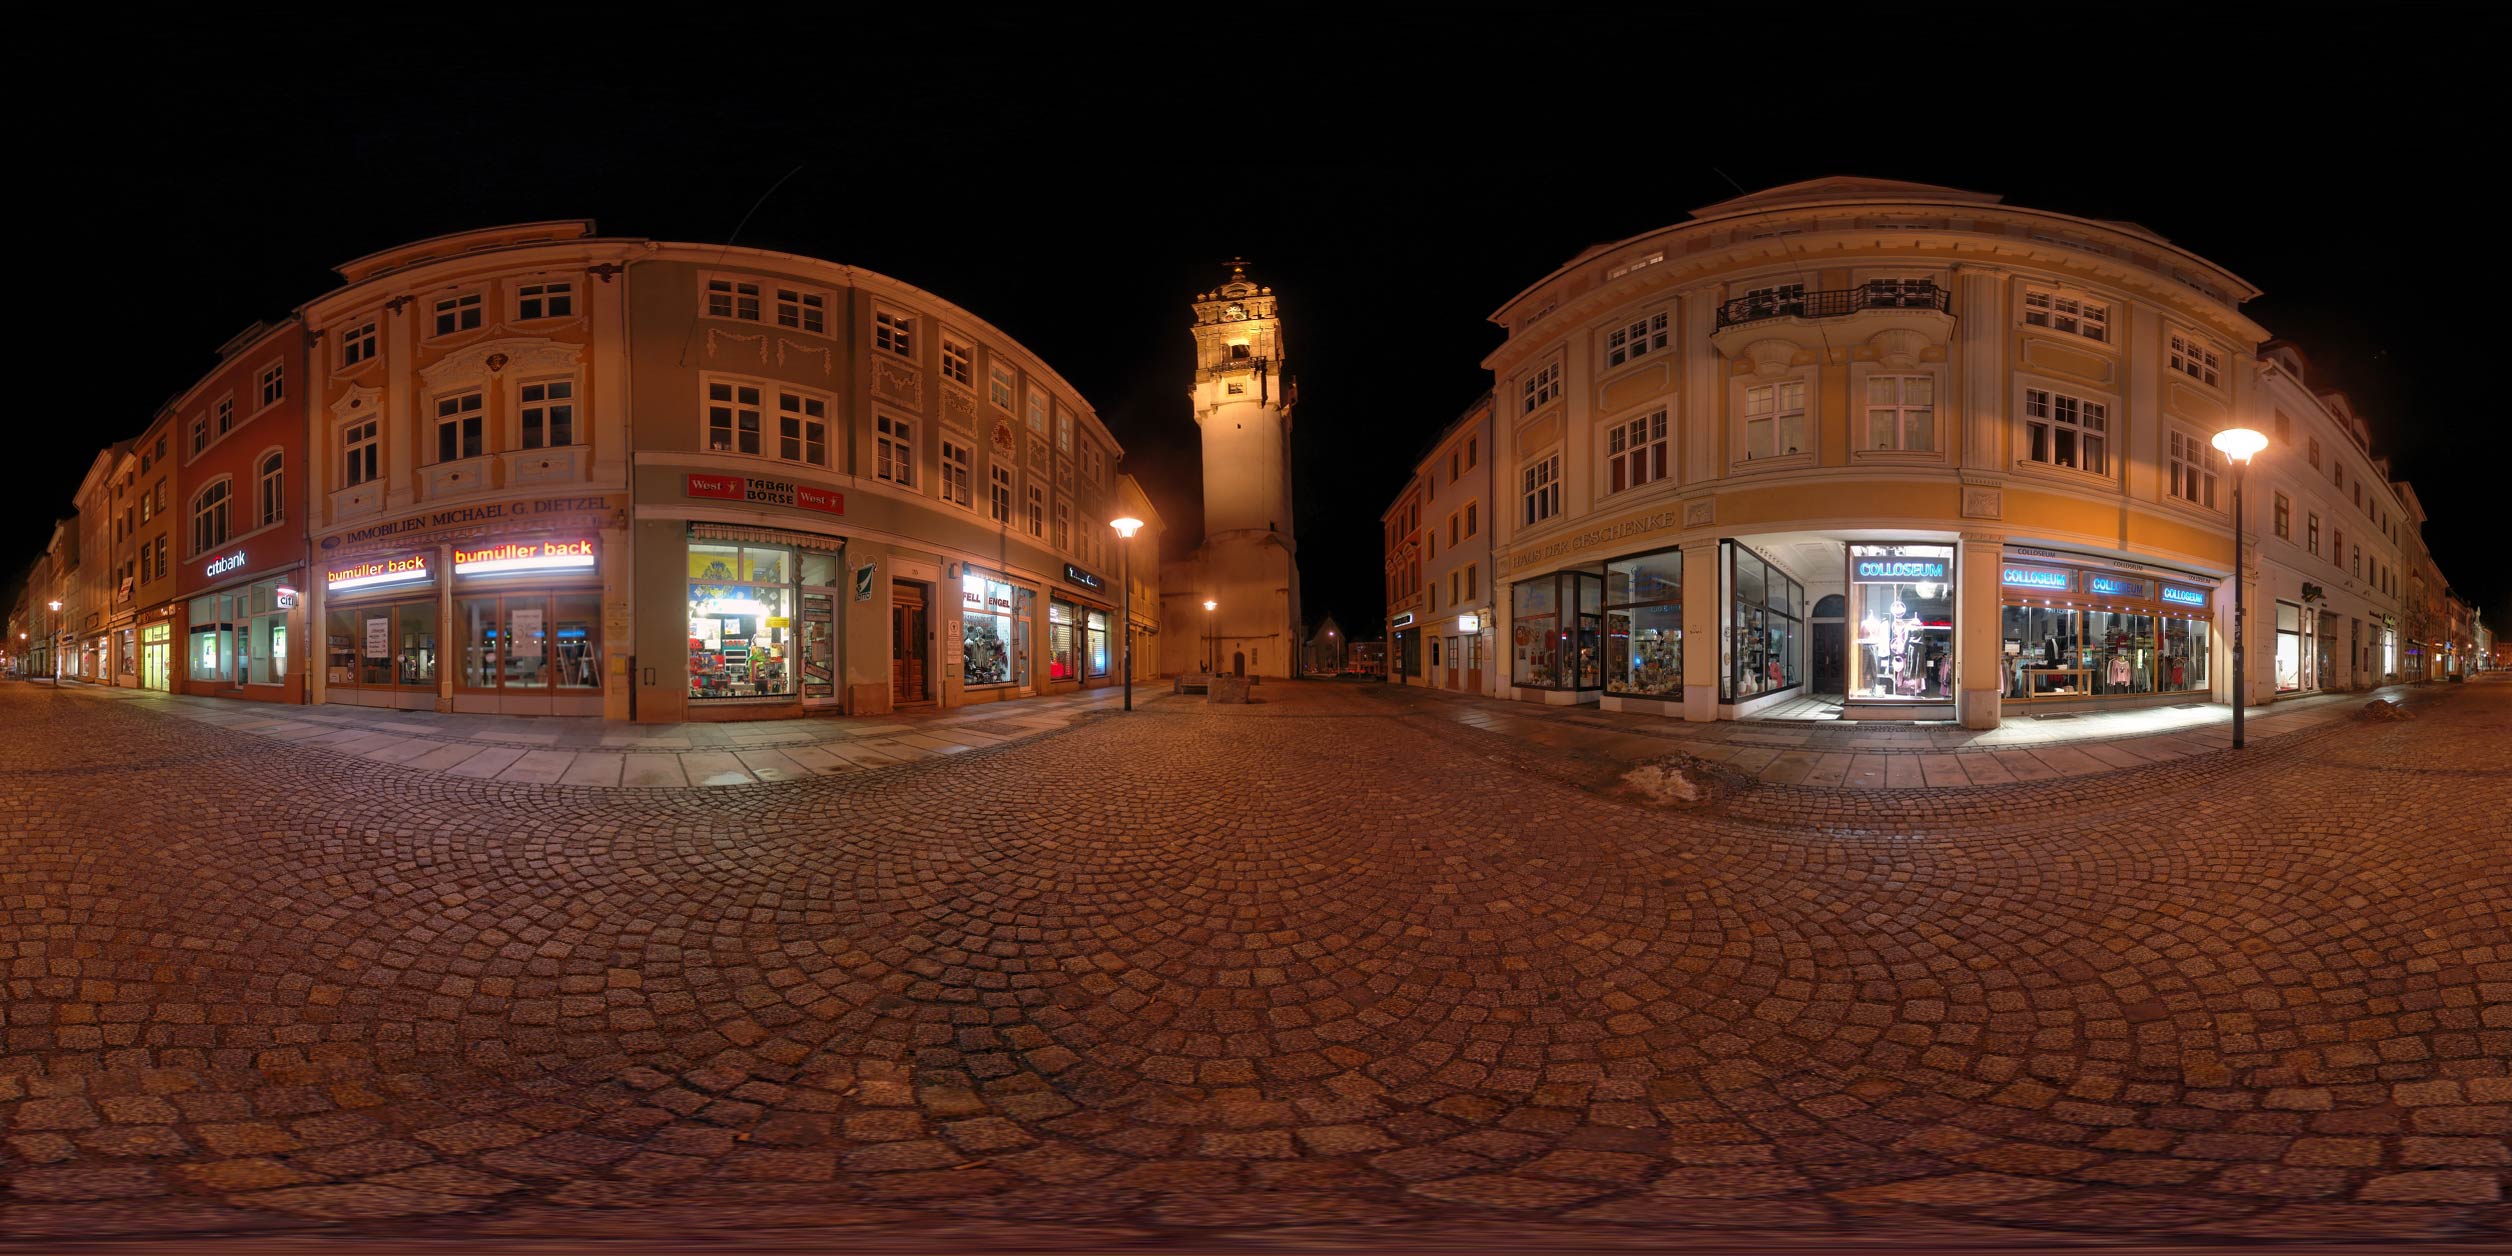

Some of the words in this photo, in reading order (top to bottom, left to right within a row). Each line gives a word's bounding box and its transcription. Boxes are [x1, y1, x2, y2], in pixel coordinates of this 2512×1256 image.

[692, 479, 723, 491] West
[746, 478, 794, 493] TABAK
[746, 489, 794, 505] BÖRSE
[800, 492, 826, 504] West
[347, 516, 426, 544] IMMOBILIEN
[432, 504, 507, 526] MICHAEL
[511, 502, 529, 515] G.
[534, 497, 611, 513] DIETZEL
[1570, 512, 1676, 550] GESCHENKE
[455, 544, 538, 564] bumüller
[543, 540, 593, 557] back
[2017, 548, 2056, 558] COLLOSEUM
[206, 550, 246, 577] citibank
[328, 563, 383, 582] bumüller
[388, 556, 425, 573] back
[1860, 562, 1943, 577] COLLOSEUM
[2003, 568, 2067, 587] COLLOSEUM
[280, 594, 294, 606] citi
[962, 592, 981, 603] FELL
[988, 597, 1010, 608] ENGEL
[2164, 587, 2203, 604] COLLOSEUM
